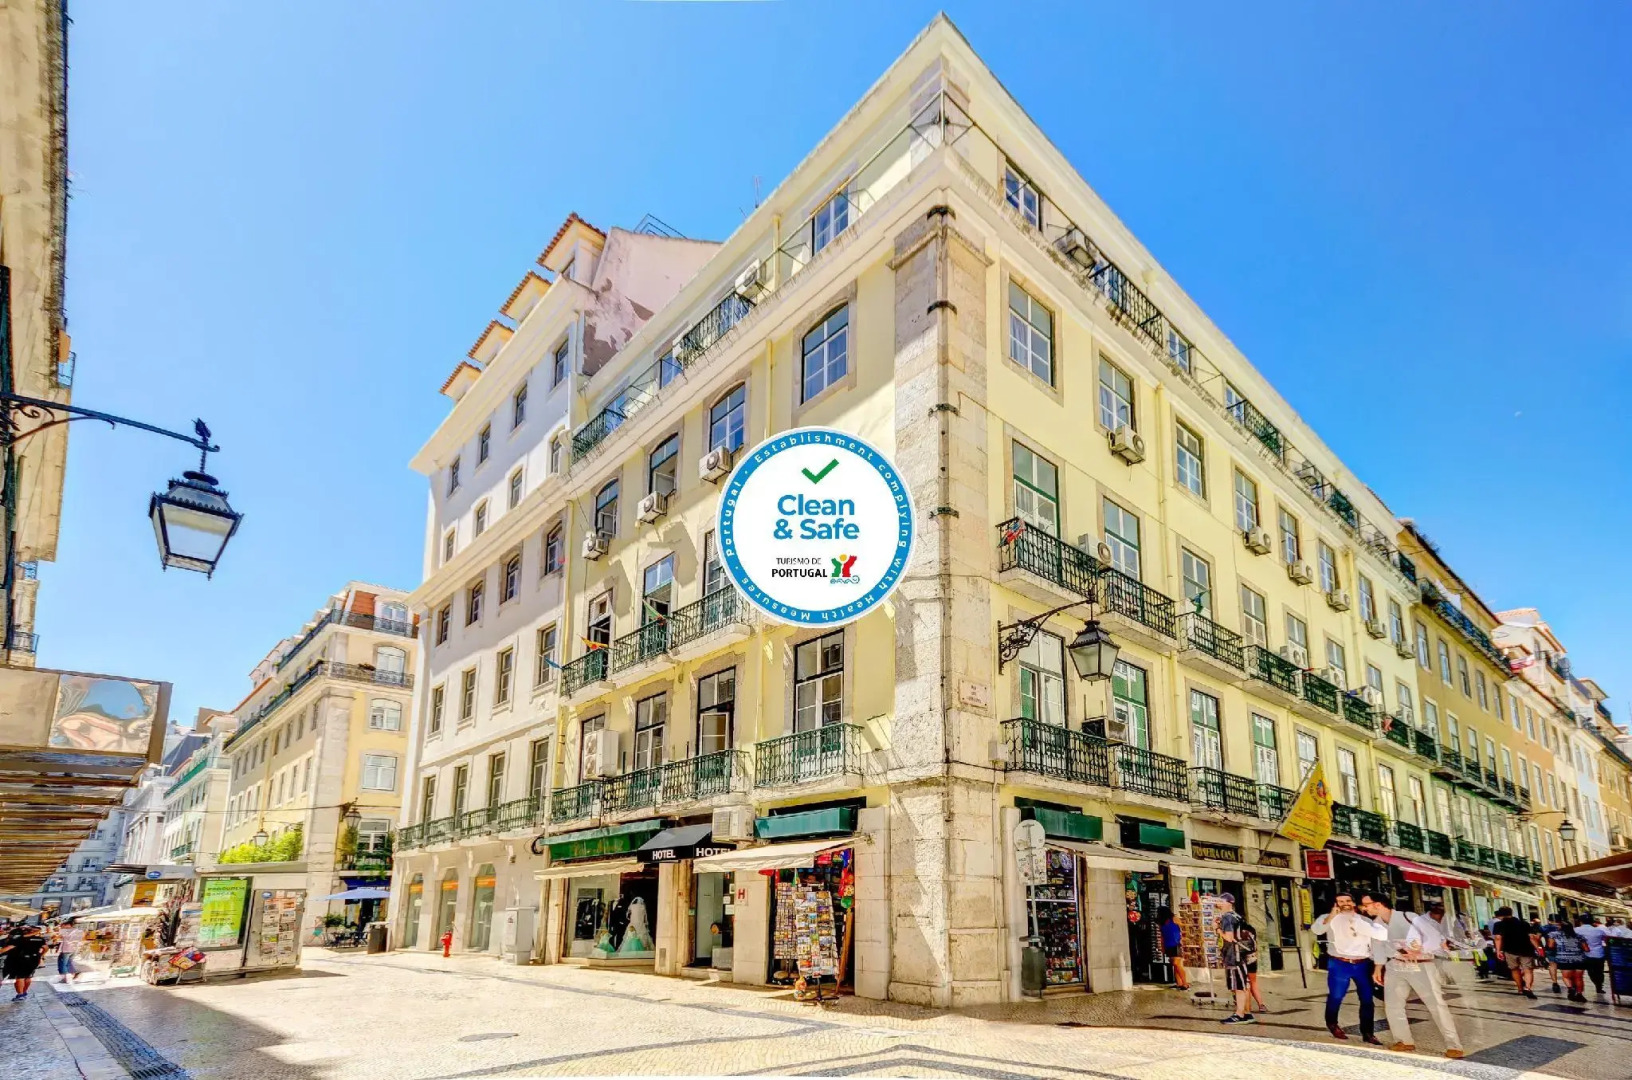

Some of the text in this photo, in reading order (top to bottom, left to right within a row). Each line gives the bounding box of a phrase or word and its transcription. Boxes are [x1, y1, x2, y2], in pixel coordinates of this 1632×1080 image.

[652, 849, 676, 860] HOTEL
[695, 847, 731, 857] HOTE
[737, 888, 746, 899] H
